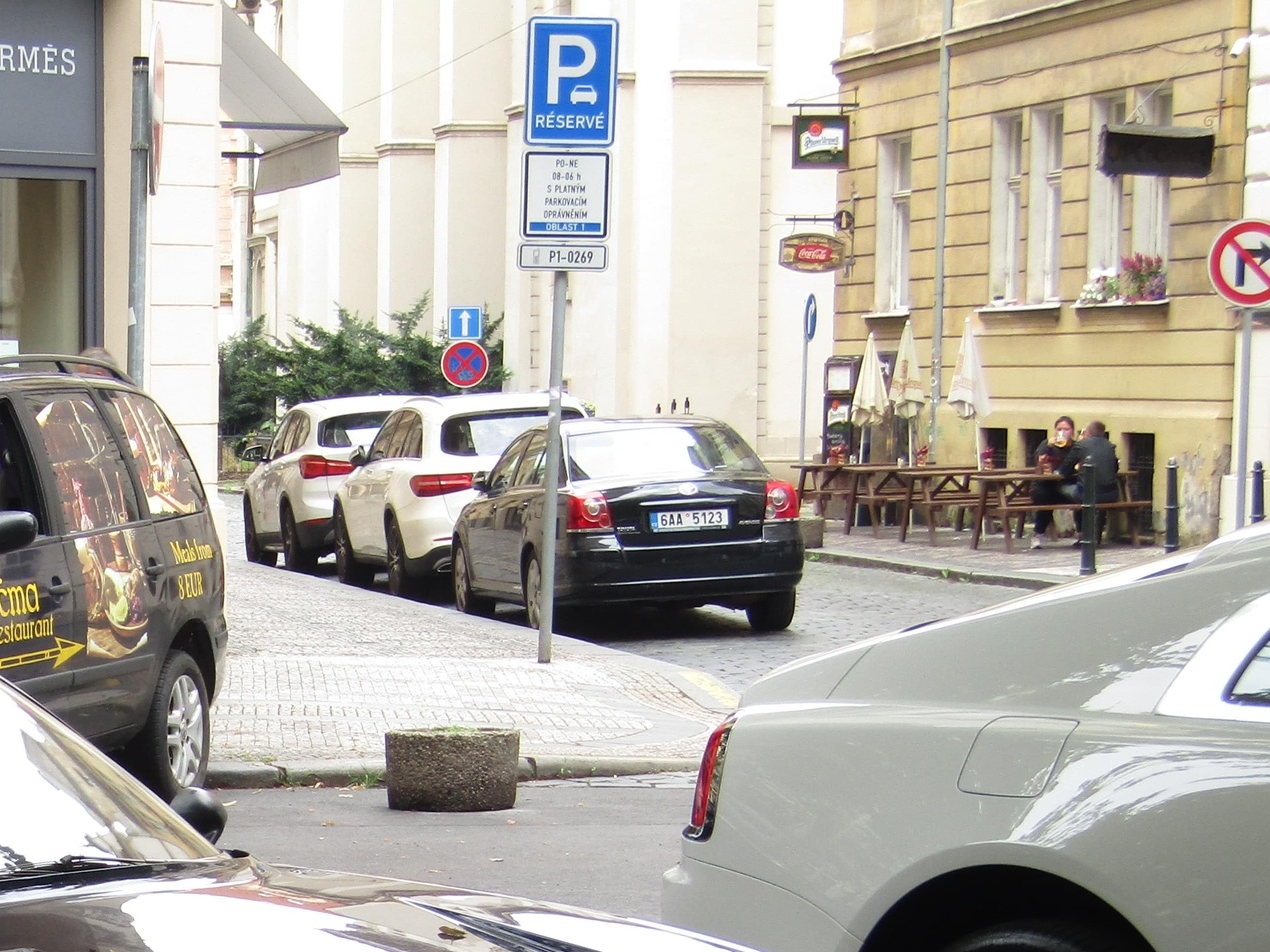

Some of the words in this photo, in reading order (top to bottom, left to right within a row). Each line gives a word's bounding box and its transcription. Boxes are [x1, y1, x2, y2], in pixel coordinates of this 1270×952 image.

[547, 34, 597, 105] P
[535, 110, 605, 130] RÉSERVÉ
[555, 158, 579, 169] PO-NE
[552, 171, 574, 182] 08-06
[577, 172, 581, 182] h
[547, 184, 552, 194] S
[554, 183, 586, 194] PLATNÝM
[544, 196, 587, 207] PARKOVACÍM
[543, 208, 588, 220] OPRÁVNĚNÍM
[545, 223, 578, 231] OBLAST
[581, 223, 586, 231] 1
[549, 250, 594, 264] P1-0269
[661, 513, 683, 527] 6AA
[692, 511, 723, 525] 5123
[177, 575, 185, 600] 8
[184, 571, 204, 598] EUR
